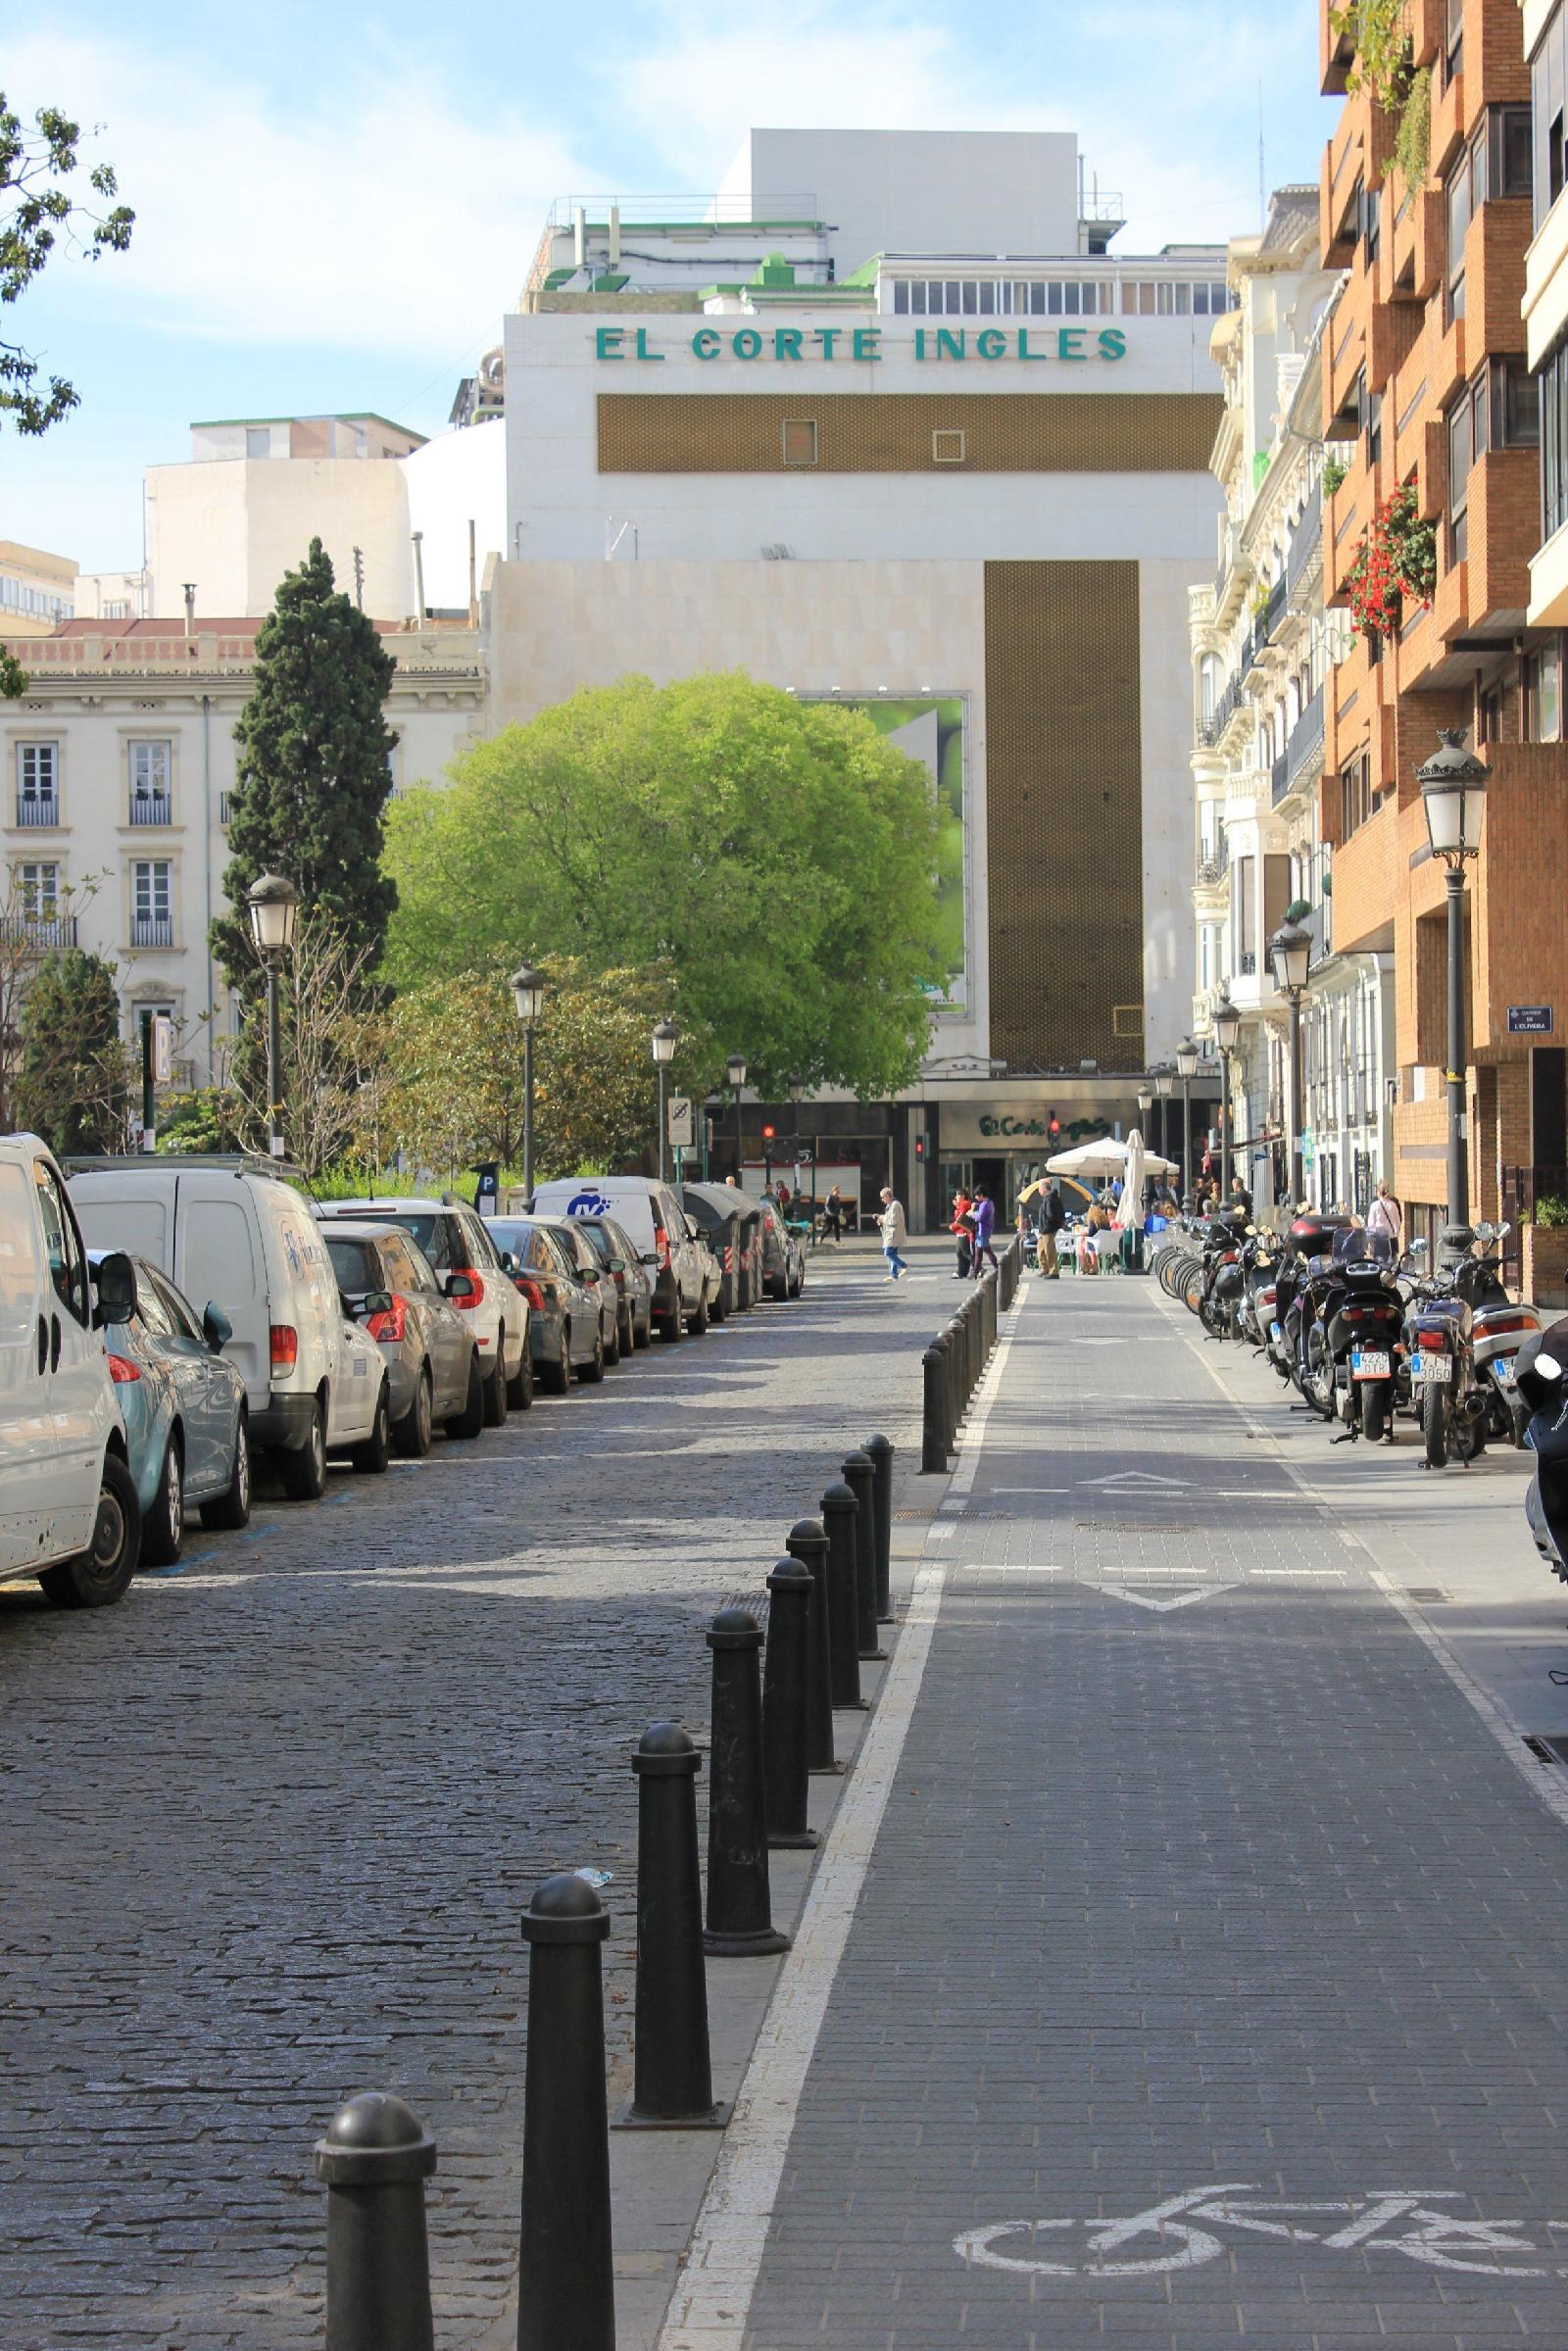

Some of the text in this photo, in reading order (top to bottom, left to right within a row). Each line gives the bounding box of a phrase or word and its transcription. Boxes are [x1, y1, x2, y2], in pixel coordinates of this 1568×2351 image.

[596, 327, 1127, 362] EL CORTE INGLES
[483, 1176, 493, 1191] P
[1421, 1368, 1450, 1380] 3050
